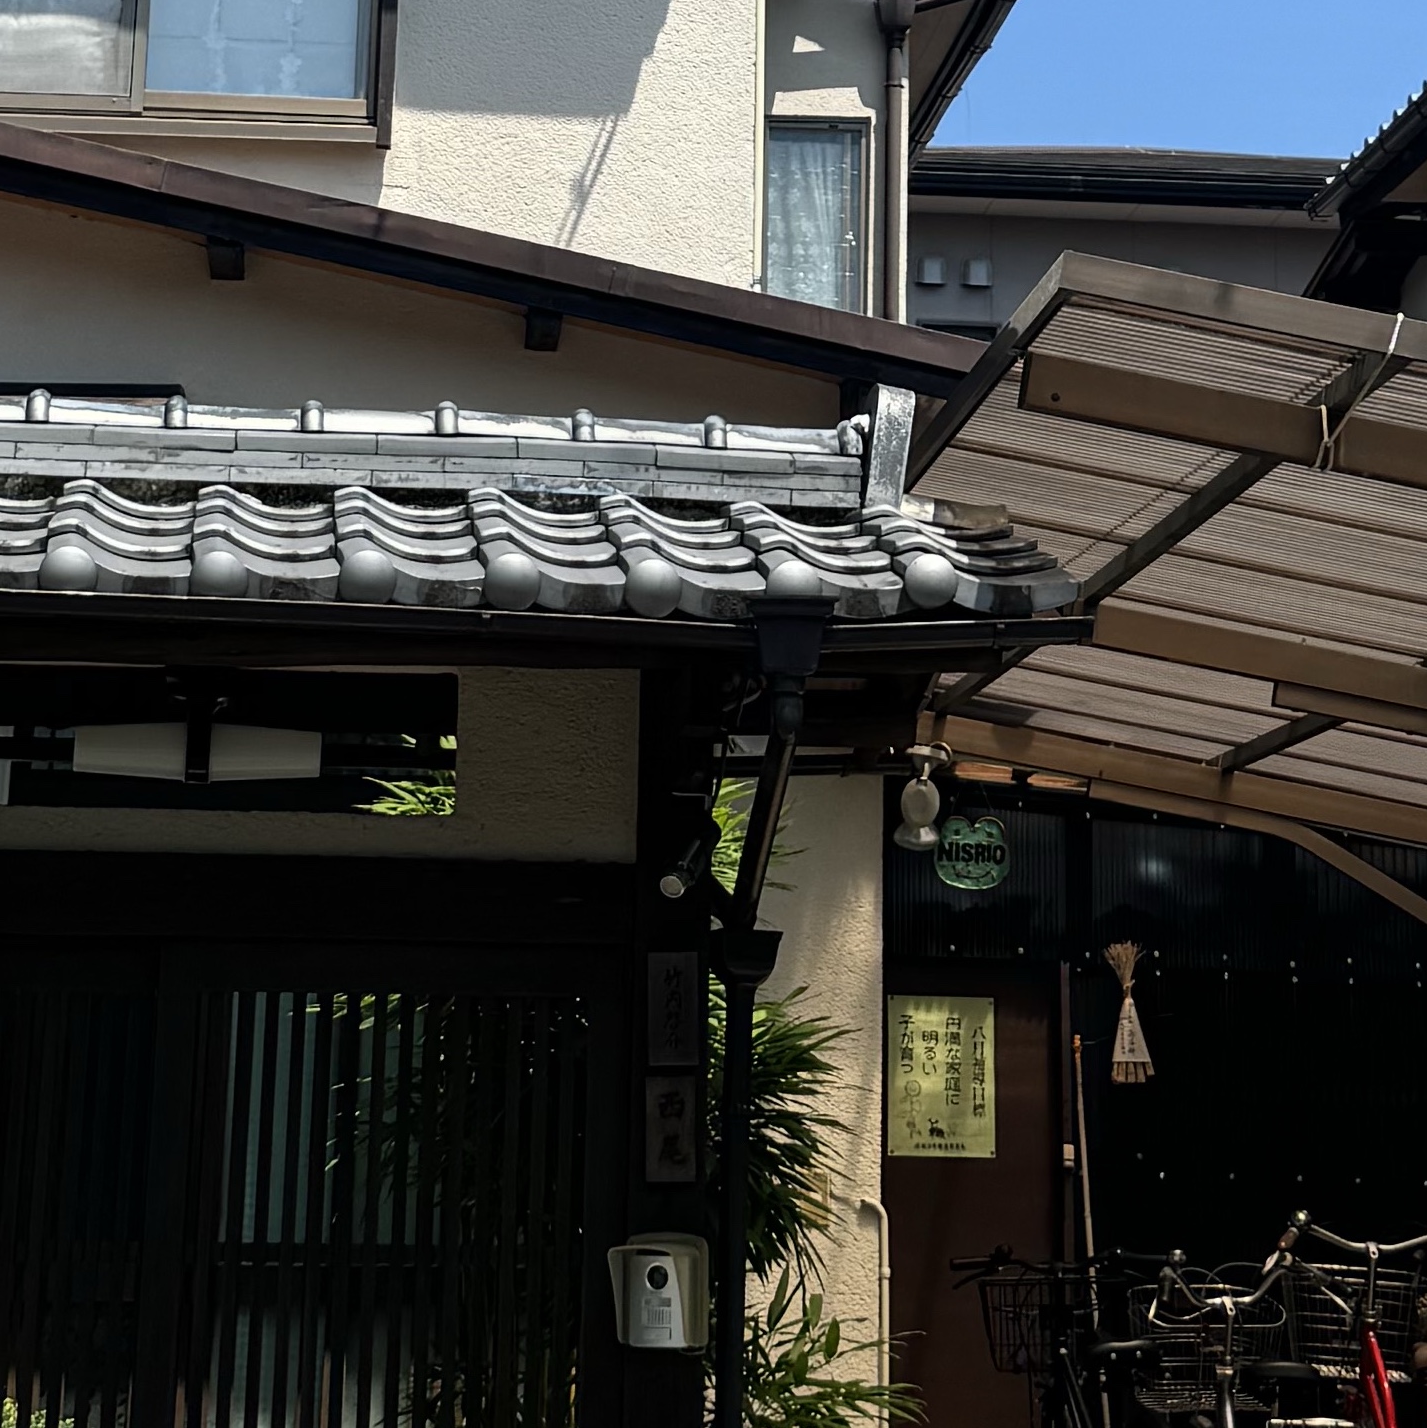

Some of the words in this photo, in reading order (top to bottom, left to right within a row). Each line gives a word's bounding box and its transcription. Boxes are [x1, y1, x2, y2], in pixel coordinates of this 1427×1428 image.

[898, 1014, 915, 1074] 子が育つ
[922, 1030, 939, 1076] 明るい
[944, 1017, 962, 1107] 円満な家庭に
[658, 1091, 688, 1165] 西尾
